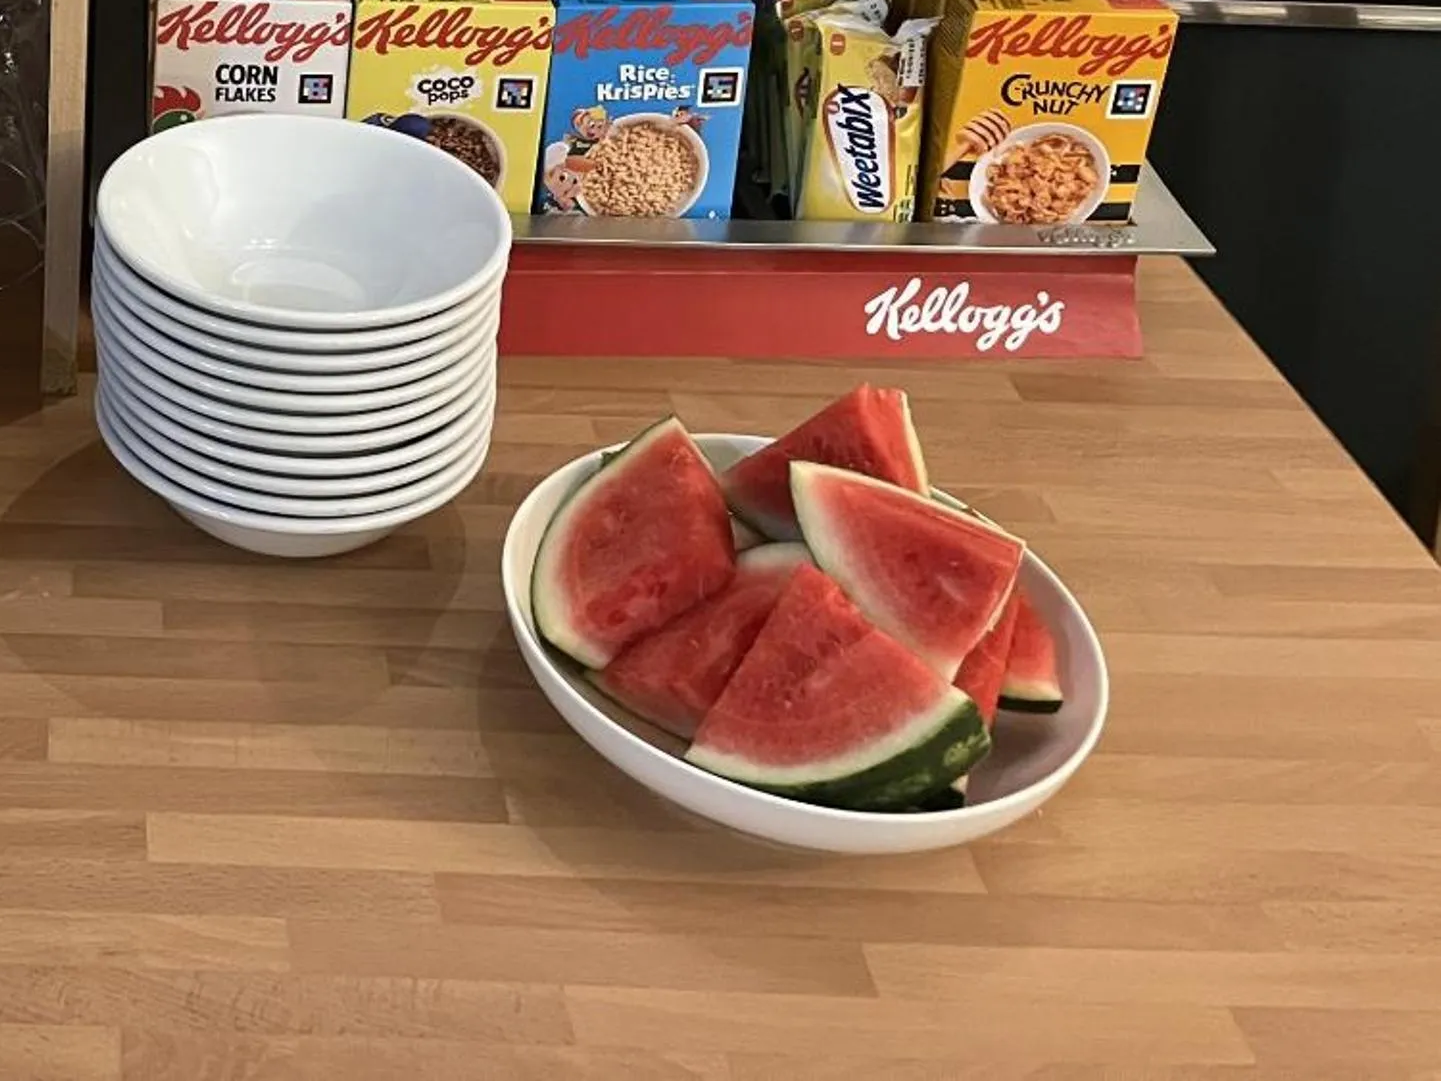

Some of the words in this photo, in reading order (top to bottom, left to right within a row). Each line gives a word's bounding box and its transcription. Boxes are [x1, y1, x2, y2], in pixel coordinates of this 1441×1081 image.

[158, 1, 351, 63] Kellogg's
[356, 6, 554, 66] Kellogg's
[554, 4, 754, 65] Kellogg's
[965, 13, 1173, 76] Kellogg's
[215, 64, 279, 86] CORN
[620, 64, 670, 83] Rice
[1001, 73, 1111, 107] CRUNCHY
[215, 88, 276, 103] FLAKES
[427, 88, 469, 105] pops
[597, 82, 691, 102] Krispies
[1033, 99, 1078, 116] NUT
[837, 84, 885, 208] Weetabix
[865, 277, 1066, 351] Kellogg's
